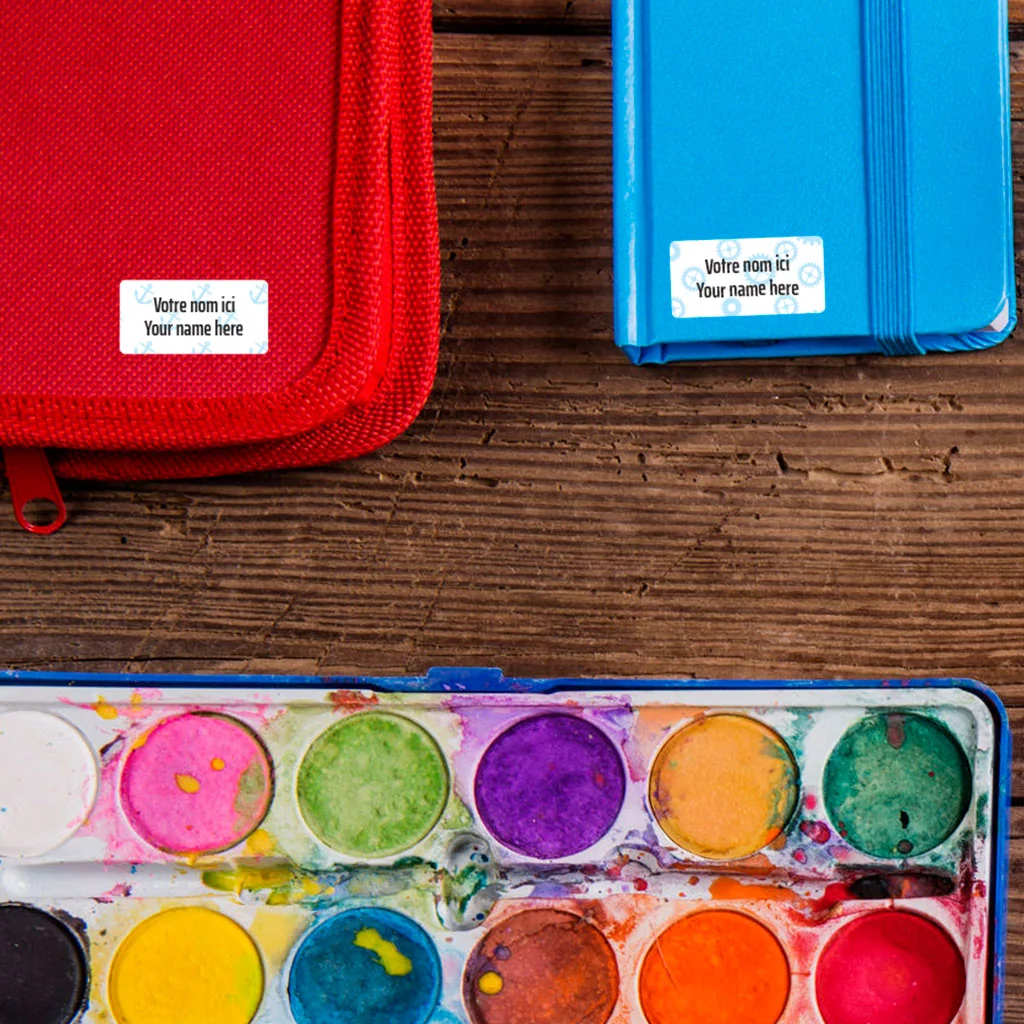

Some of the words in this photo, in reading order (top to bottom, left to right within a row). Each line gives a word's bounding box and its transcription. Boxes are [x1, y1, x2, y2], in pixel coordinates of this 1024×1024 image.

[705, 258, 740, 274] Votre
[743, 260, 772, 273] nom
[776, 254, 790, 271] ici
[696, 282, 726, 298] Your
[729, 283, 766, 296] name
[770, 279, 799, 295] here
[153, 297, 187, 313] Votre
[190, 300, 218, 313] nom
[222, 296, 235, 313] ici
[144, 320, 173, 336] Your
[176, 323, 212, 336] name
[215, 319, 243, 336] here
